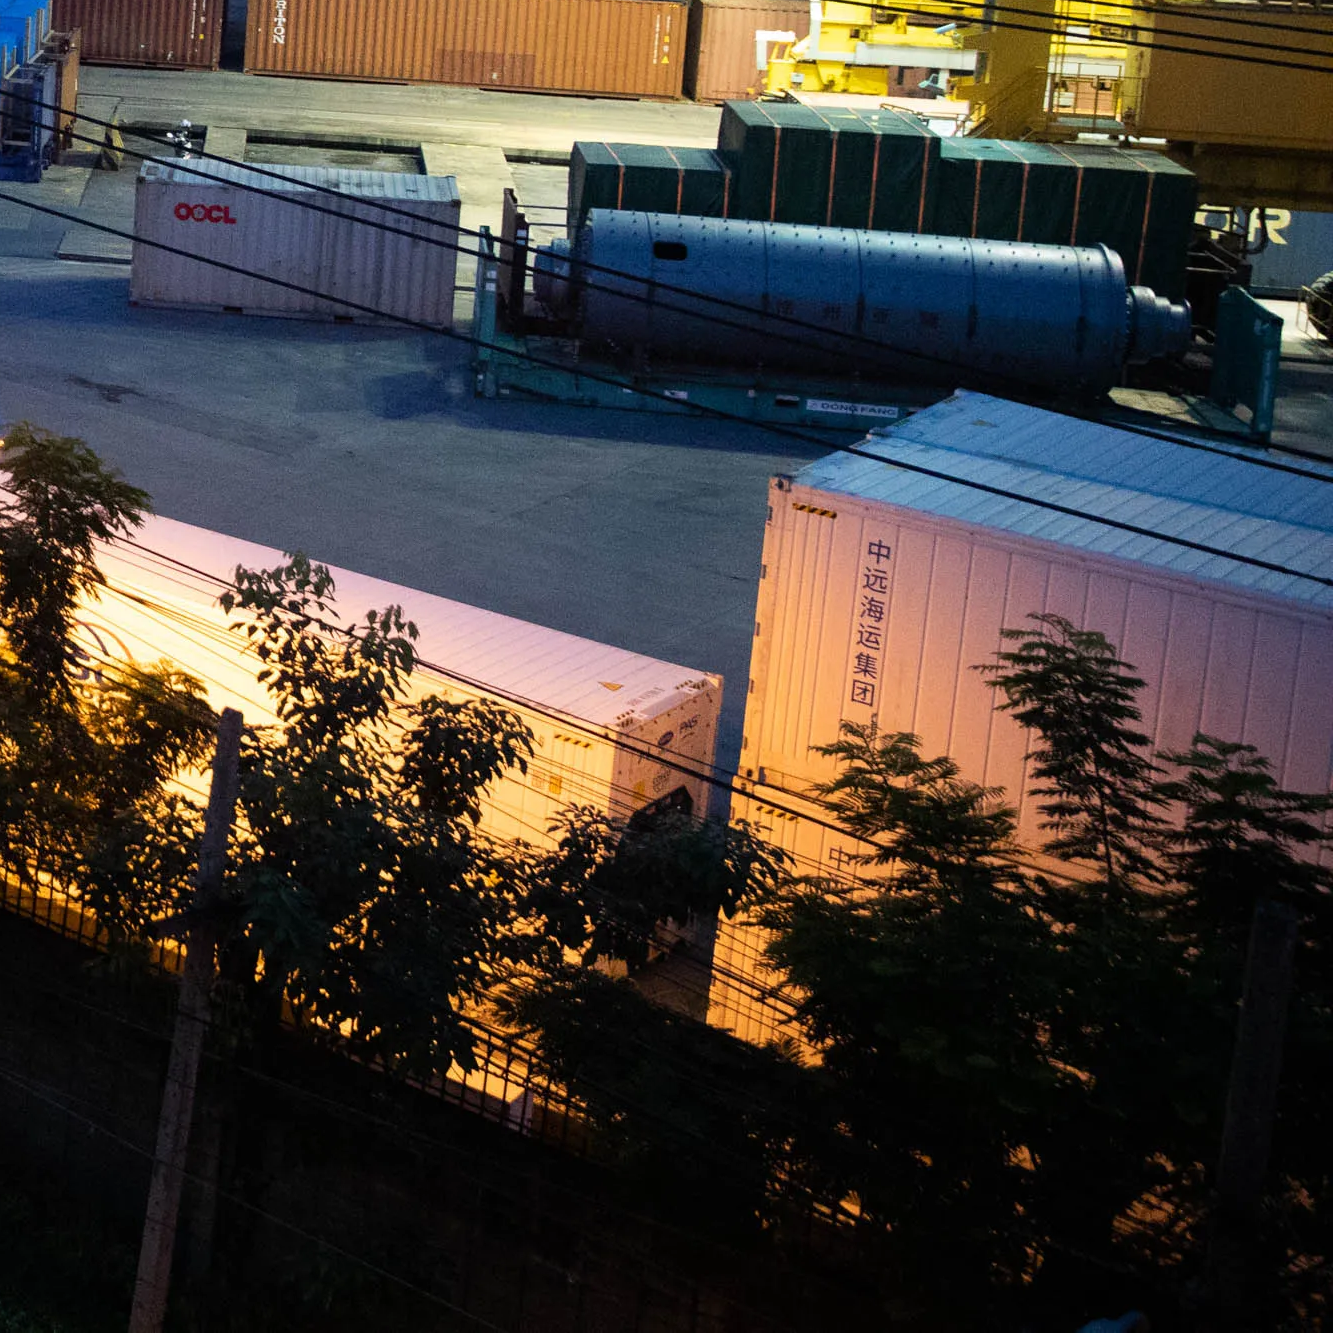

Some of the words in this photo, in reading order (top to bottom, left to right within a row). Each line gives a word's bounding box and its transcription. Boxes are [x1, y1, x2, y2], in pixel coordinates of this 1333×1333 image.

[174, 202, 237, 224] OOCL
[820, 402, 858, 412] DONG
[860, 406, 897, 416] FANG
[850, 539, 892, 707] 中远海运集团
